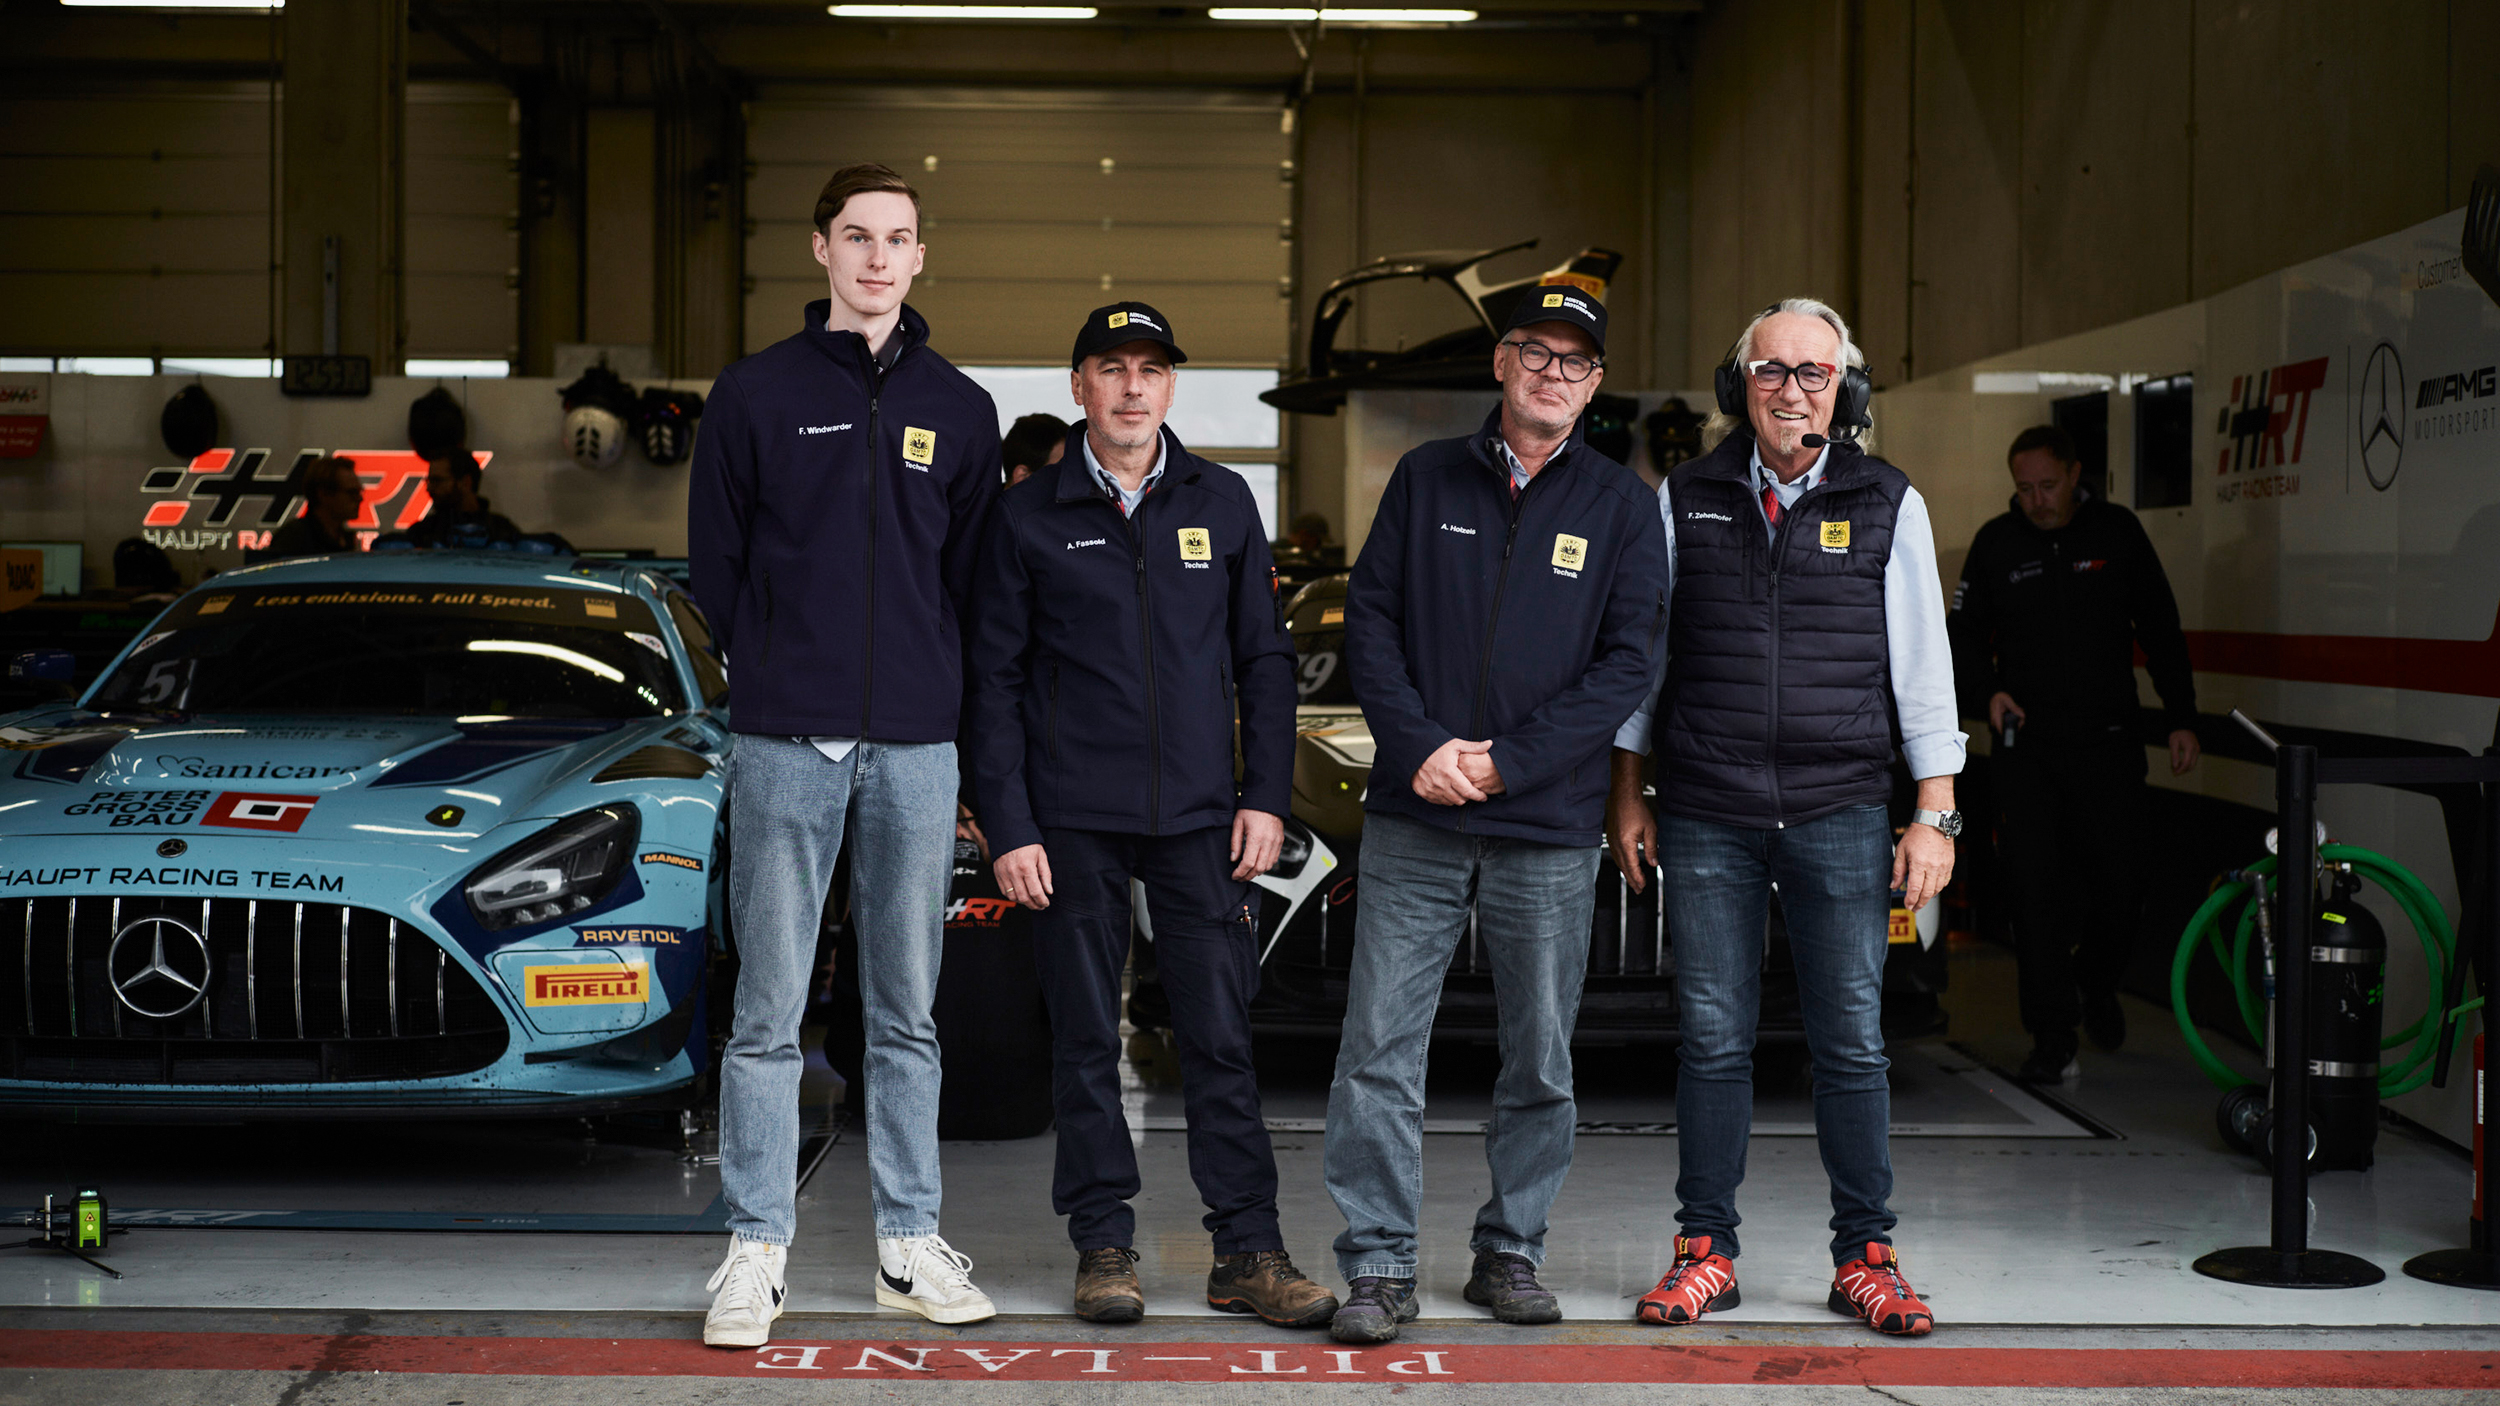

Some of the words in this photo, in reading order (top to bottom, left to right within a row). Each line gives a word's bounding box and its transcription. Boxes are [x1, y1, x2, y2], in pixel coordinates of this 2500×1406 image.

[2438, 366, 2496, 405] AMG
[2226, 356, 2329, 472] HRT
[798, 427, 807, 435] F.
[807, 422, 853, 434] Windwarder
[2415, 407, 2496, 440] MOTORSPORT
[904, 461, 930, 473] Technik
[2274, 473, 2300, 496] TEAM
[1695, 512, 1733, 522] Zehethofer
[1440, 523, 1449, 531] A.
[143, 530, 233, 551] HAUPT
[1066, 542, 1075, 550] A.
[1076, 538, 1106, 548] Fassold
[1552, 567, 1578, 580] Technik
[253, 594, 301, 608] Less
[304, 591, 424, 606] emissions.
[430, 592, 476, 606] Full
[478, 594, 557, 610] Speed.
[89, 790, 211, 803] PETER
[63, 800, 203, 816] GROSS
[109, 813, 194, 828] BAU
[644, 853, 701, 870] MANNOL
[109, 868, 239, 887] RACING
[251, 871, 344, 892] TEAM
[582, 929, 681, 945] RAVENOL
[535, 971, 639, 999] PIRELLI
[756, 1345, 1456, 1375] PIT-LANE
